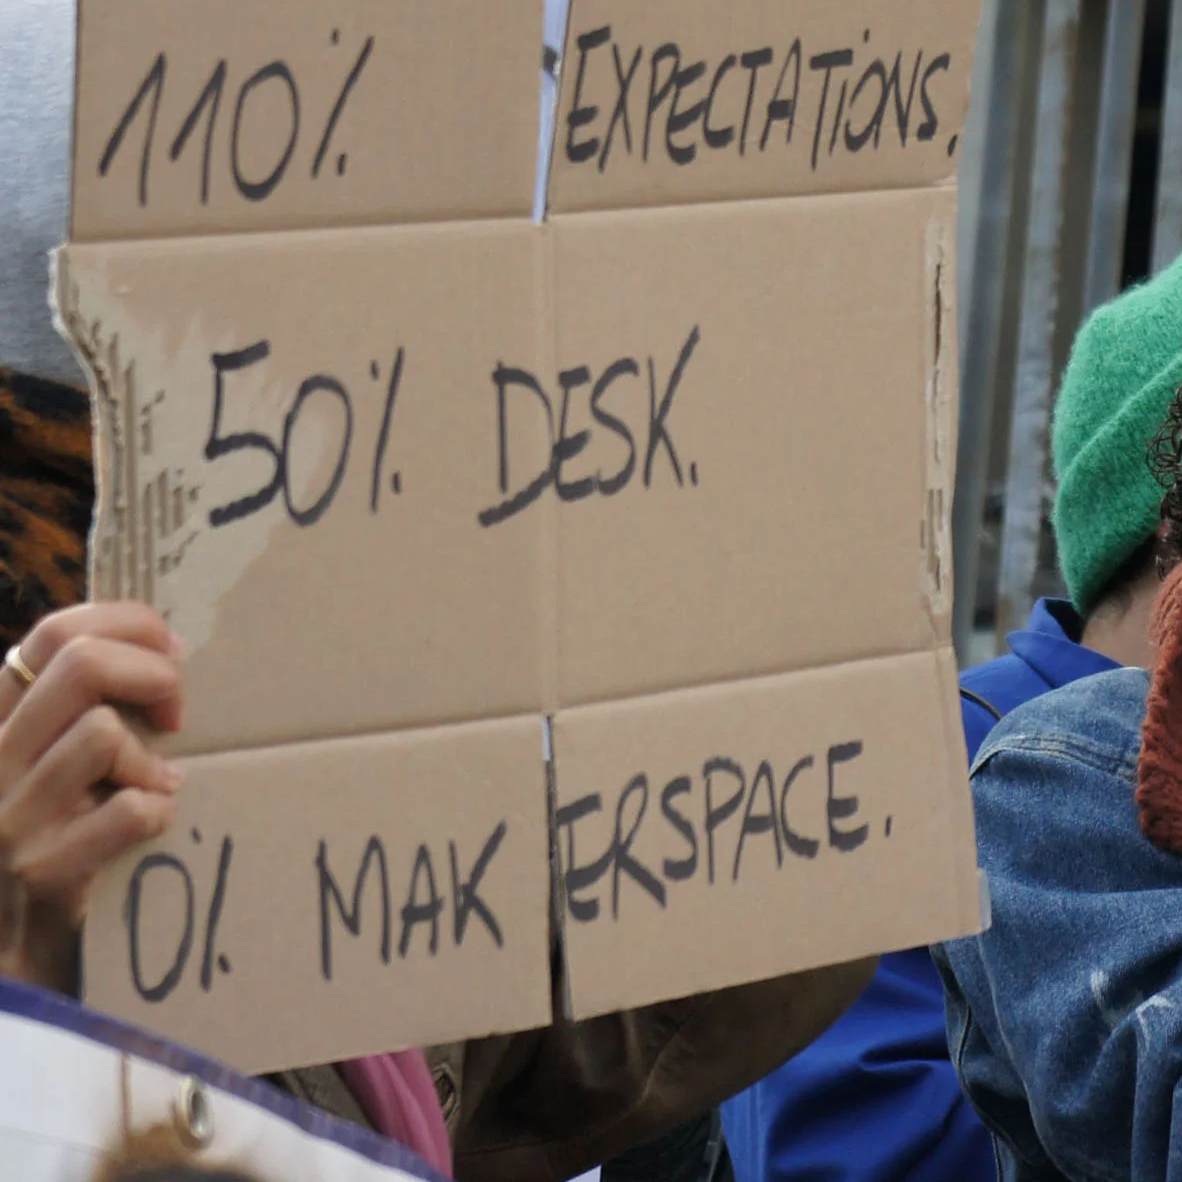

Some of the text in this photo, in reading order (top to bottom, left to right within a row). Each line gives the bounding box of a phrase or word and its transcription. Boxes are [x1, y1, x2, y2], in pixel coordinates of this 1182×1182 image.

[97, 27, 374, 205] 110%
[204, 324, 700, 529] 50% DESK.
[124, 825, 234, 1003] 0%
